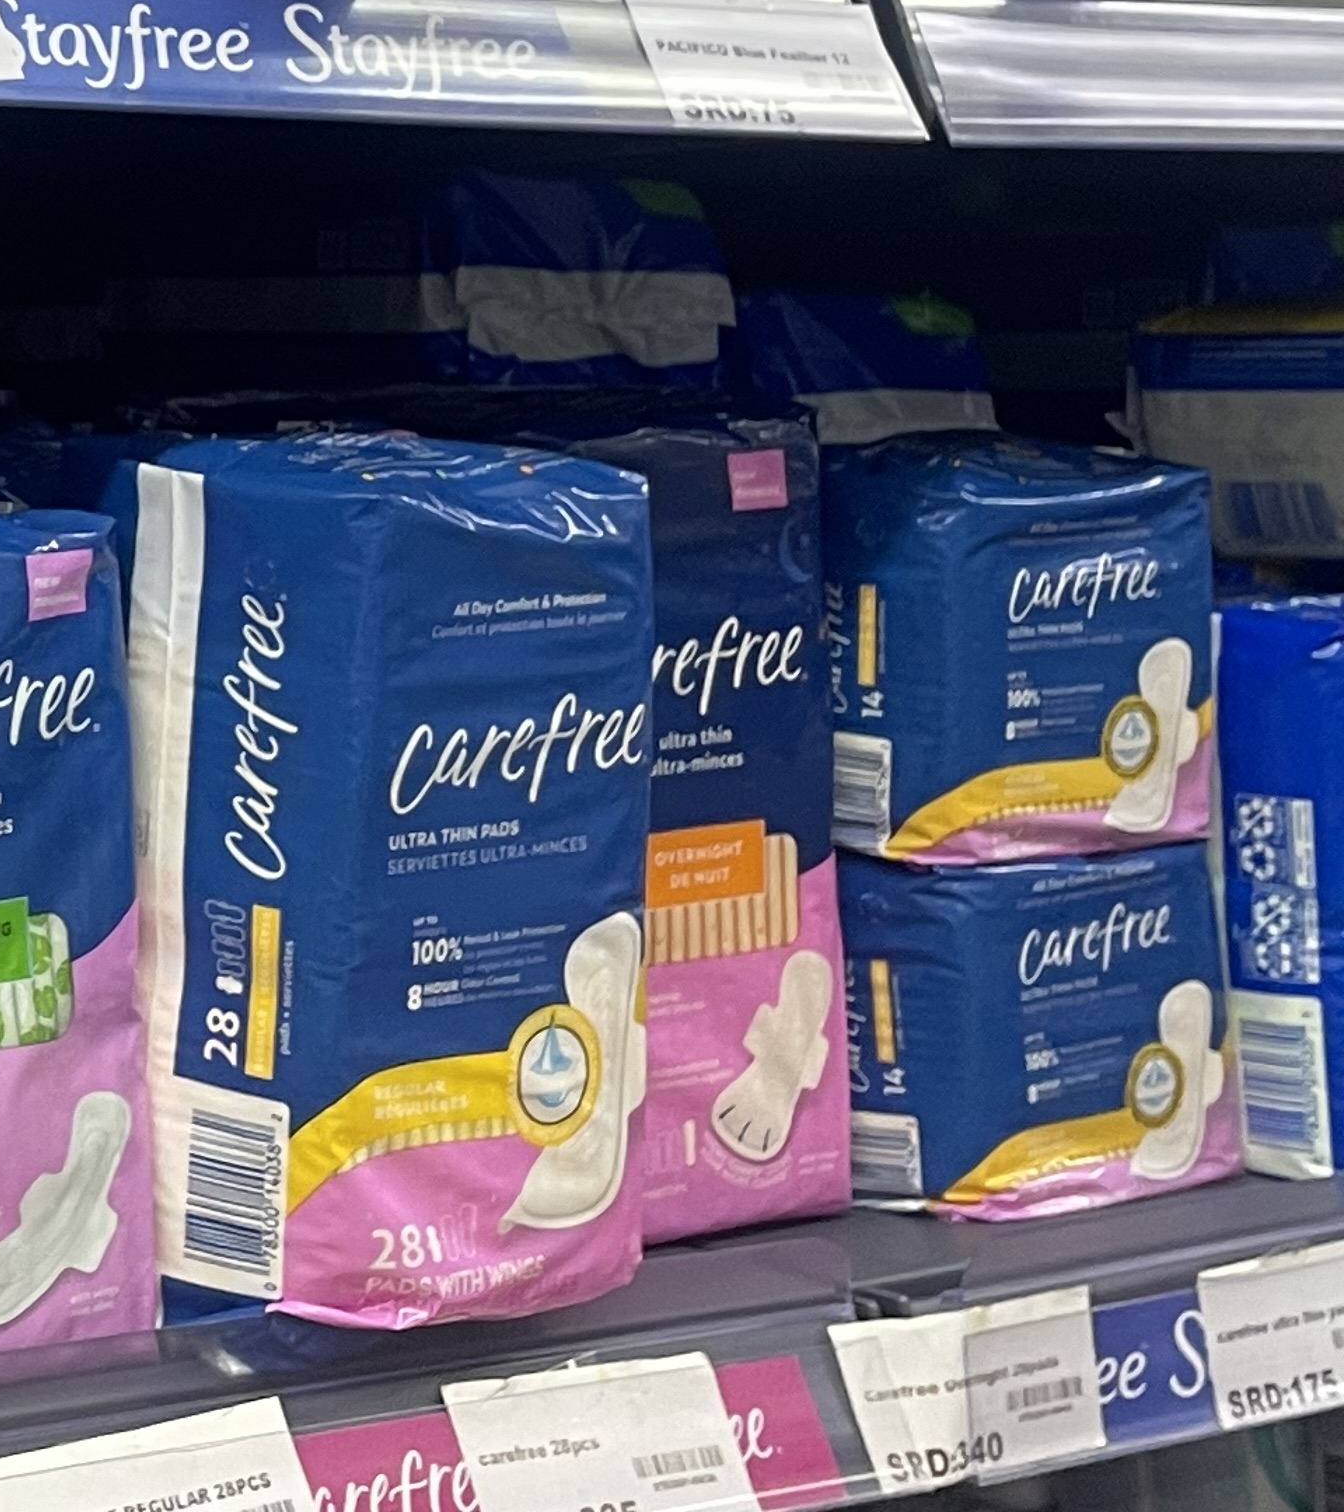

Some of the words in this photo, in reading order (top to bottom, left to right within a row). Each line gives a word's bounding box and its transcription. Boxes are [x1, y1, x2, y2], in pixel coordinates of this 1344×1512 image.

[284, 3, 537, 98] Stayfree
[651, 616, 802, 715] refree
[659, 731, 696, 750] ultra
[700, 725, 732, 745] thin
[388, 831, 437, 852] ULTRA
[440, 824, 479, 844] THIN
[481, 819, 520, 839] PADS
[387, 849, 476, 875] SERVIETTES
[480, 835, 588, 864] ULTRA-MINCES
[655, 841, 744, 866] OVERNIGHT
[412, 936, 463, 966] 100%
[407, 984, 422, 1011] 8
[204, 1012, 239, 1066] 28
[371, 1224, 426, 1269] 28
[1228, 1370, 1338, 1418] SRD:175
[478, 1445, 546, 1467] carefree
[549, 1438, 600, 1458] 28pcs
[213, 1472, 271, 1500] 28PCS
